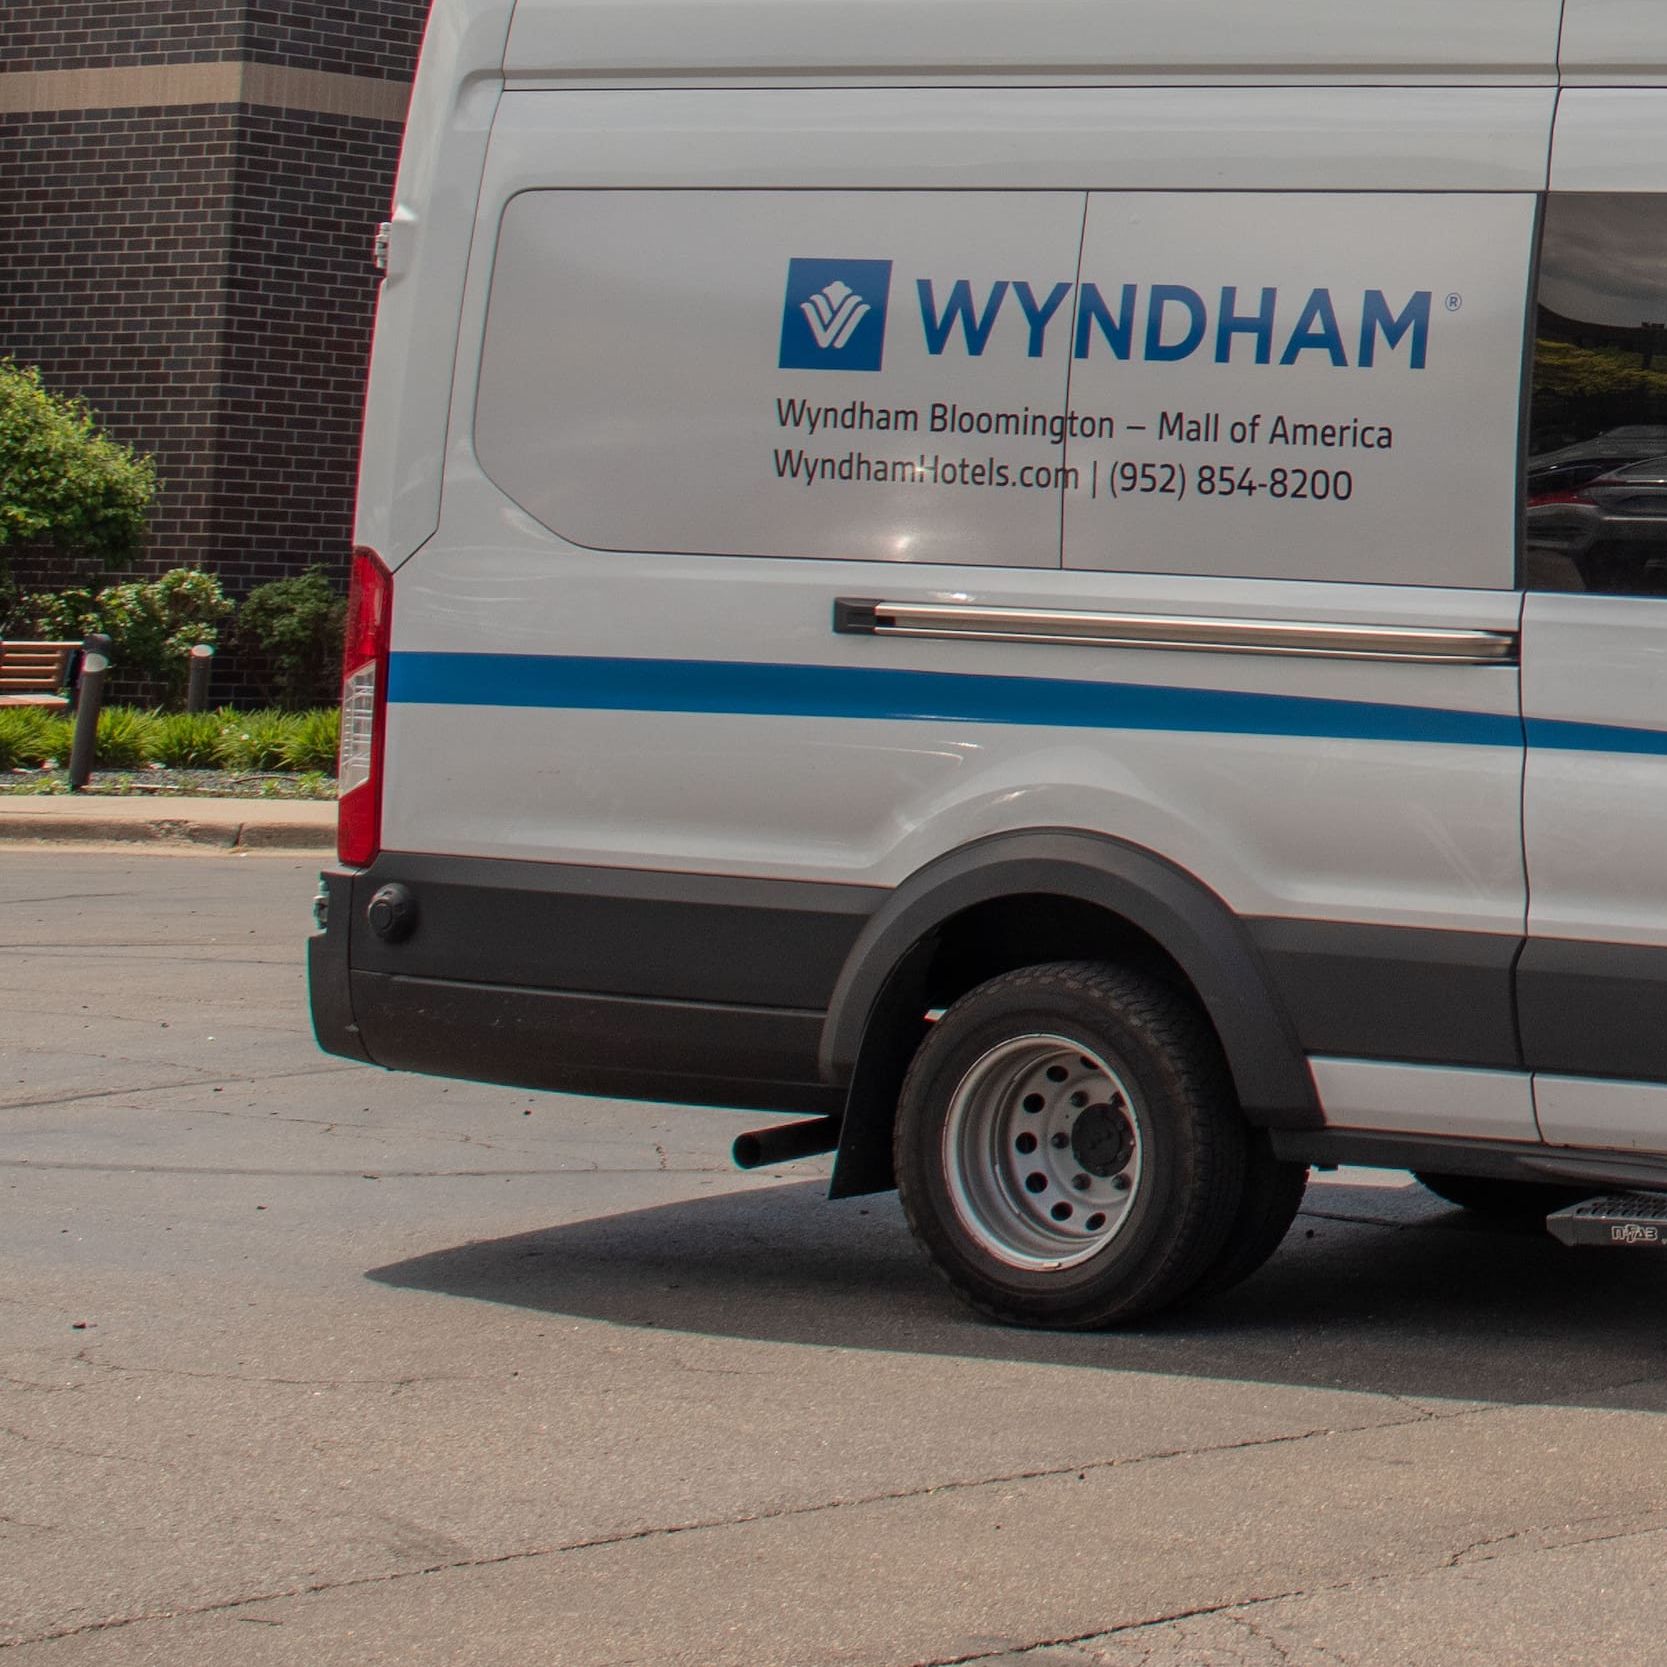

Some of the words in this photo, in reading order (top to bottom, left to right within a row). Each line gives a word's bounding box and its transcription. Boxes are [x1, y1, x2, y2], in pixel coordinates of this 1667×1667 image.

[776, 397, 919, 435] Wyndham
[929, 403, 1115, 445] Bloomington
[1158, 411, 1219, 443] Mall
[1229, 414, 1262, 444] of
[1268, 414, 1393, 450] America
[774, 448, 1079, 490] WyndhamHotels.com
[1110, 461, 1186, 502] (952)
[1196, 464, 1353, 502] 854-8200
